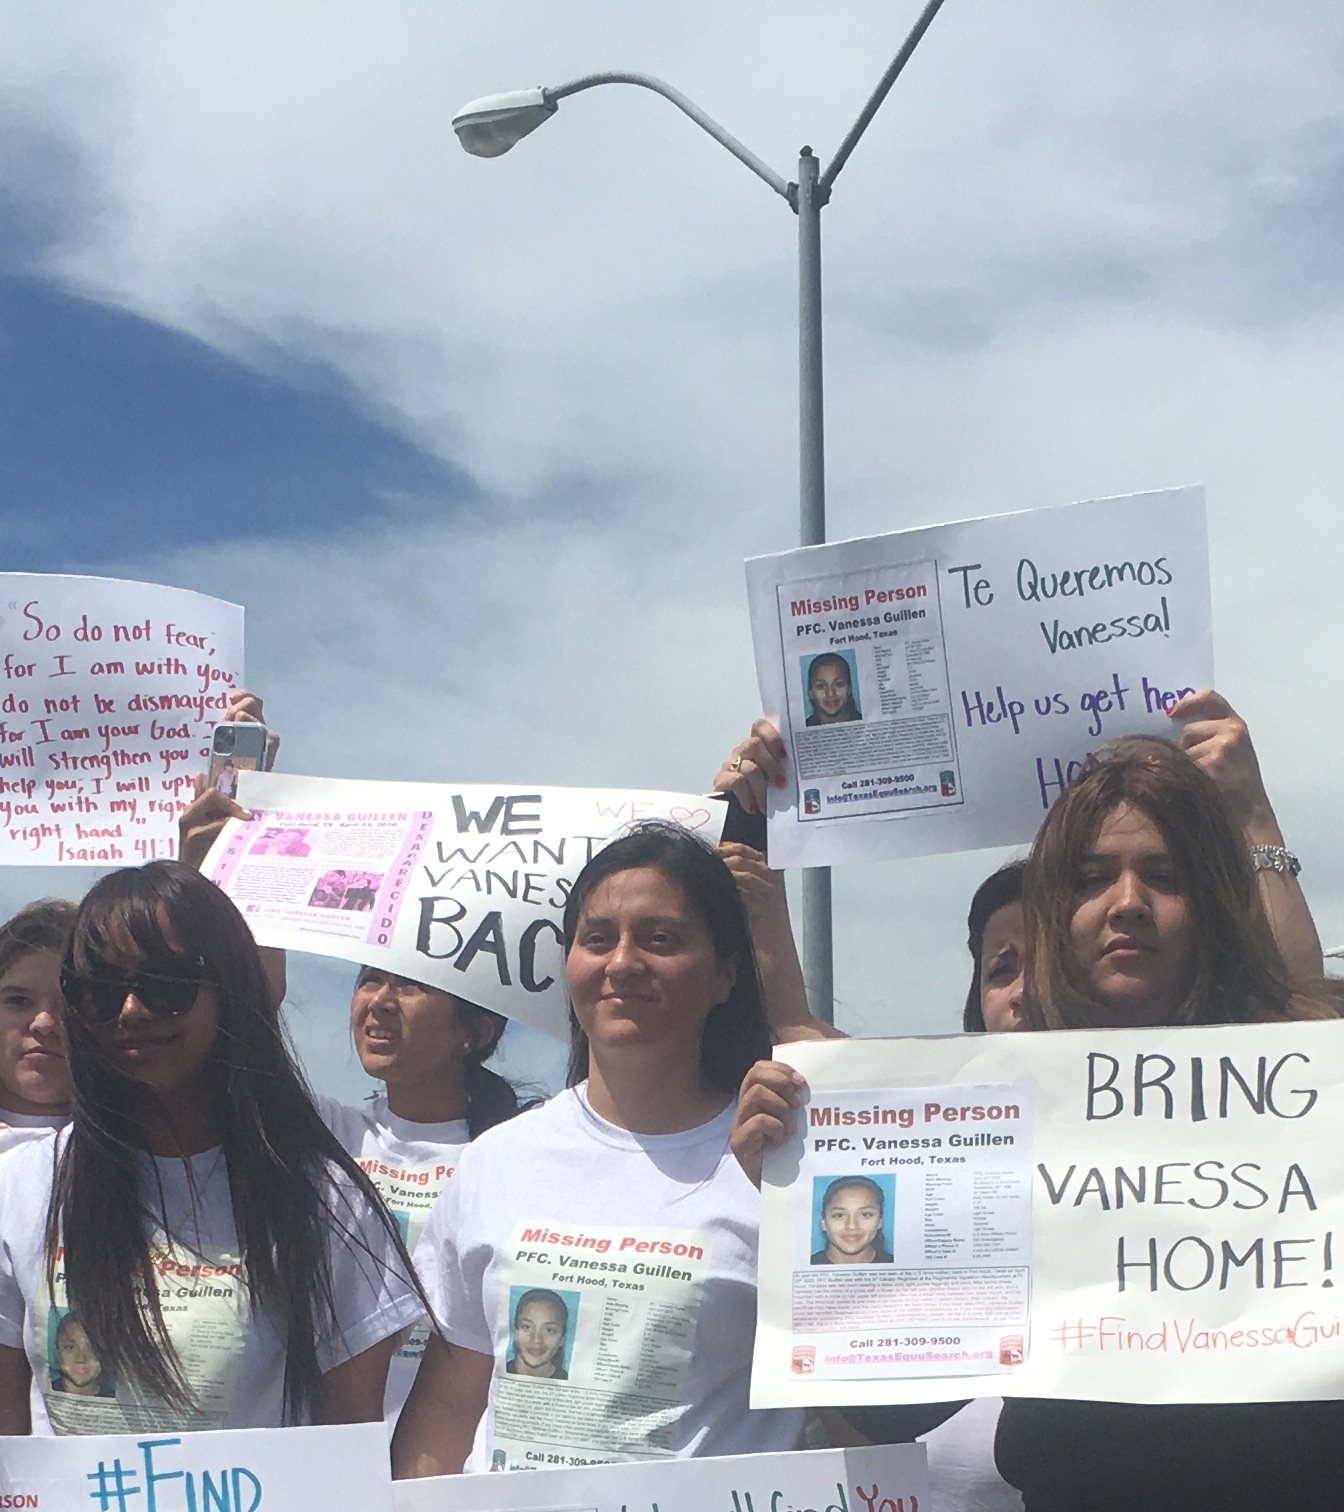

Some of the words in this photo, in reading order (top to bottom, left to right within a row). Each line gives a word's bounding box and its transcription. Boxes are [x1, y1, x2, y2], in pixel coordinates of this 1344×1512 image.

[948, 564, 993, 609] Te
[1016, 557, 1172, 601] Queremos
[791, 594, 860, 617] Missing
[865, 584, 927, 605] Person
[1040, 597, 1170, 653] Vanessa!
[4, 654, 36, 679] for
[48, 656, 77, 678] I
[90, 661, 125, 675] am
[135, 657, 187, 676] with
[2, 695, 29, 713] do
[44, 698, 80, 714] not
[96, 695, 115, 712] be
[961, 686, 1024, 734] Help
[1035, 694, 1069, 714] us
[1081, 673, 1128, 736] get
[0, 750, 35, 769] will
[49, 747, 152, 780] strengthen
[159, 751, 189, 772] you
[451, 794, 542, 836] WE
[10, 823, 63, 850] right
[436, 835, 606, 865] WANT
[1086, 1052, 1318, 1122] BRING
[810, 1104, 915, 1128] Missing
[924, 1101, 1020, 1124] Person
[814, 1137, 856, 1151] PFC.
[863, 1133, 942, 1150] Vanessa
[948, 1132, 1014, 1148] Guillen
[861, 1156, 887, 1167] Fort
[890, 1156, 924, 1169] Hood,
[929, 1155, 966, 1166] Texas
[1037, 1161, 1318, 1214] VANESSA
[520, 1228, 611, 1254] Missing
[619, 1235, 703, 1260] Person
[515, 1250, 552, 1265] PFC.
[559, 1255, 627, 1275] Vanessa
[632, 1263, 692, 1282] Guillen
[1117, 1232, 1334, 1292] HOME!
[850, 1337, 873, 1349] Call
[877, 1335, 961, 1349] 281-309-9500
